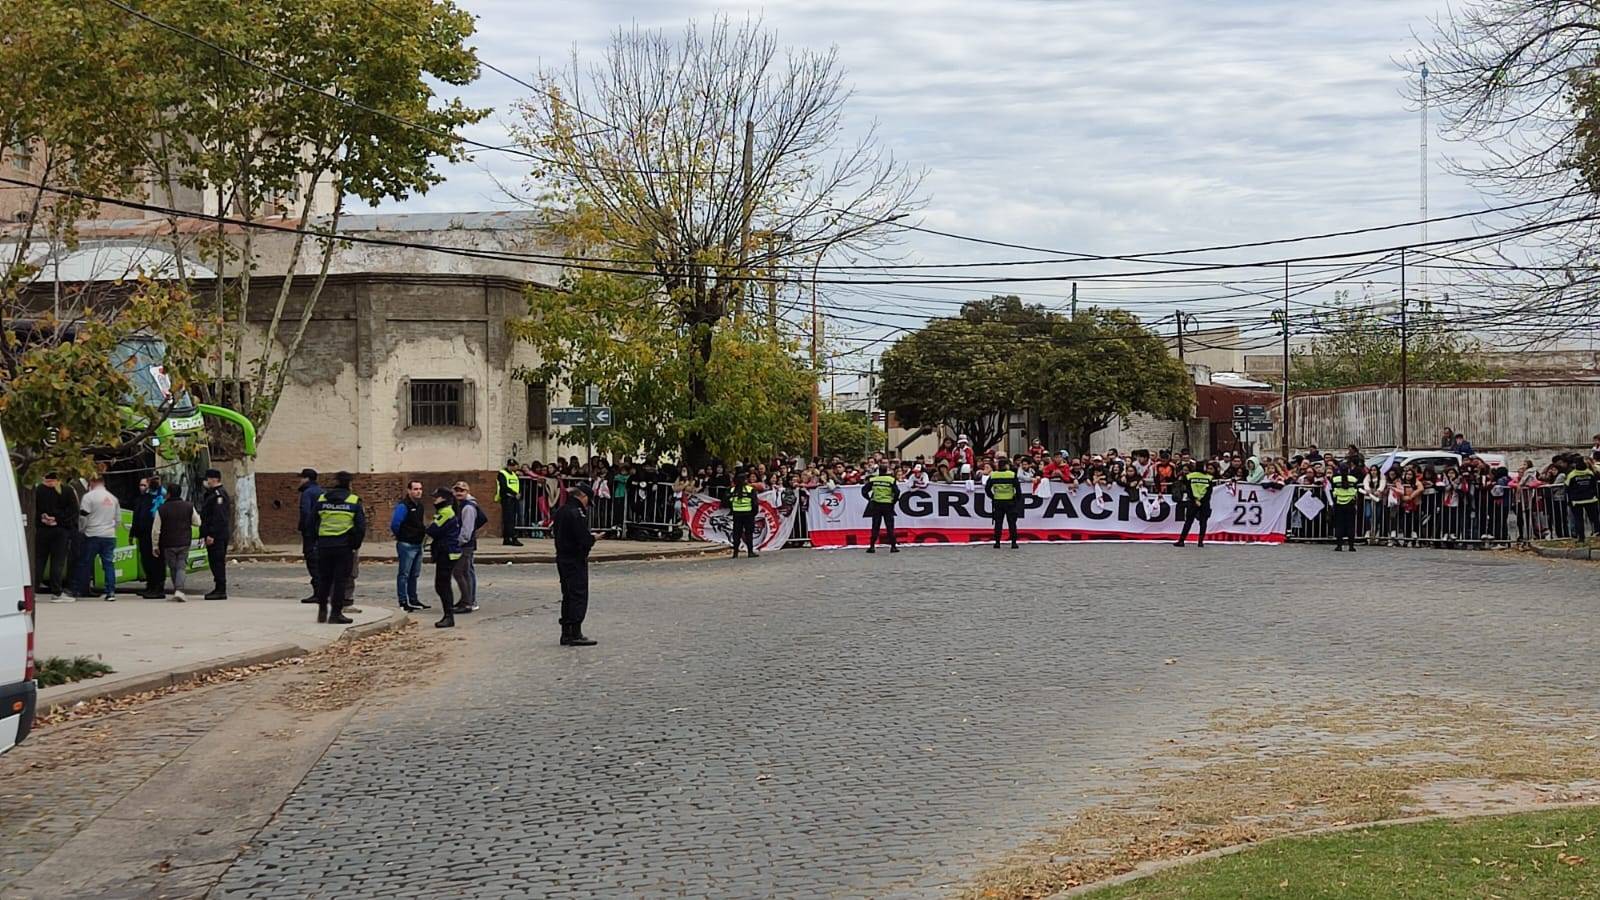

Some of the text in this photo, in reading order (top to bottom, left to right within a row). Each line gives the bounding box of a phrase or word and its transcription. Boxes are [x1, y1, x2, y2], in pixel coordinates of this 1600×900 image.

[825, 498, 840, 507] 23
[1238, 490, 1259, 503] LA
[862, 489, 1192, 522] GRUPACIO
[1232, 505, 1263, 526] 23
